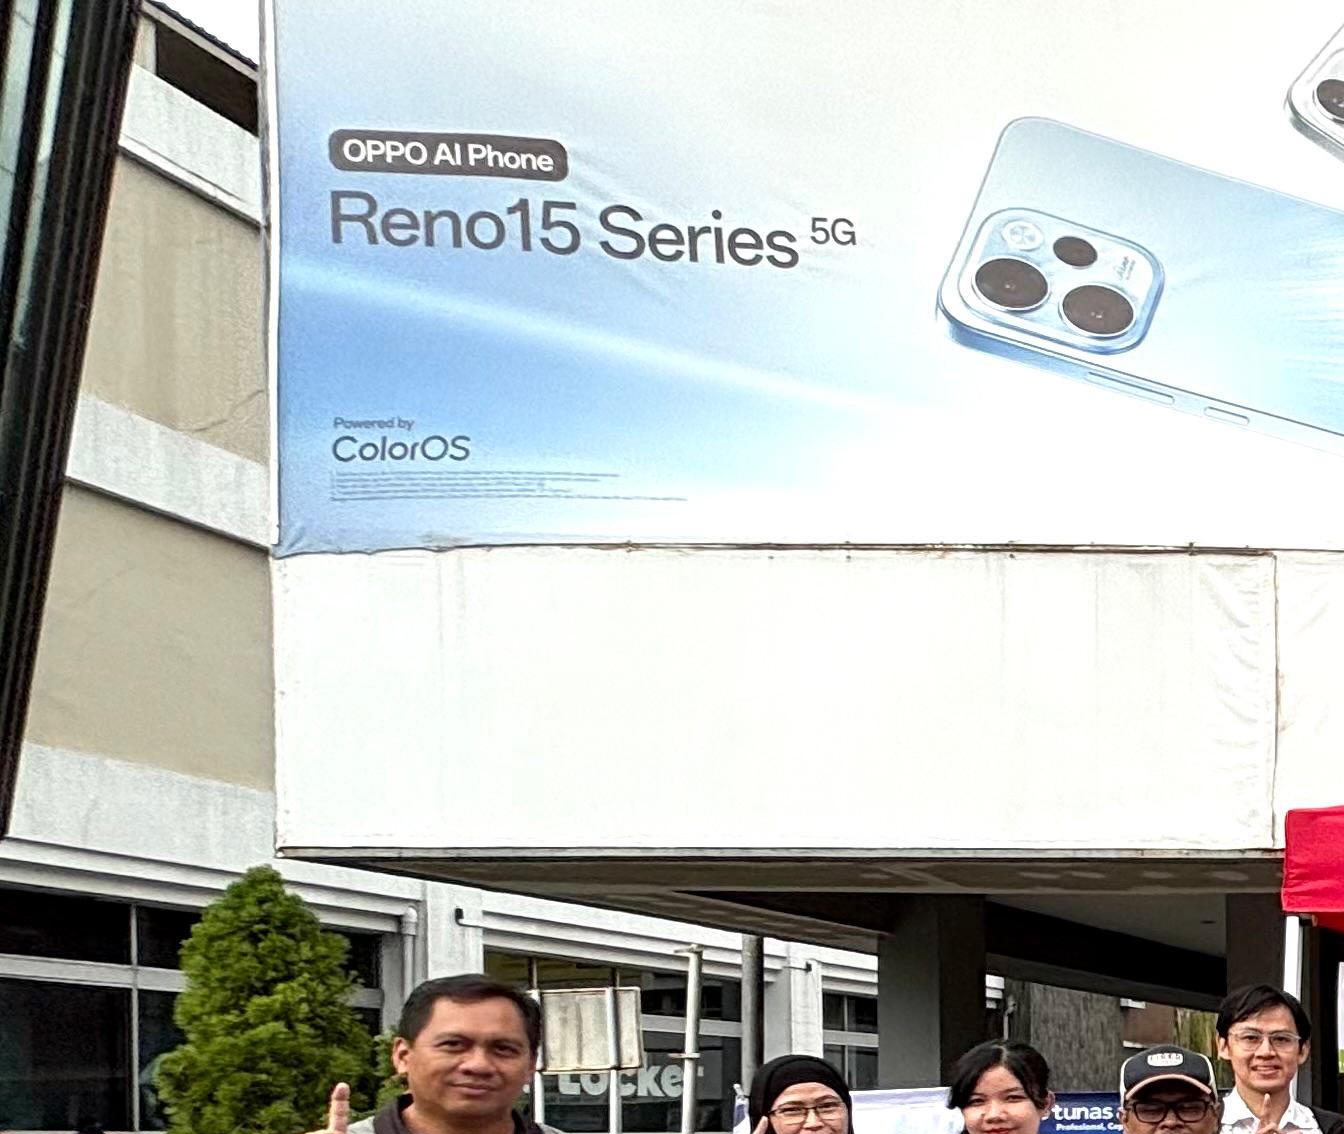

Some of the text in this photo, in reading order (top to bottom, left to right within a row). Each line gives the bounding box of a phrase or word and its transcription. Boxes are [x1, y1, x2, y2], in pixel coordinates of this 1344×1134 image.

[342, 138, 555, 172] OPPO AI Phone
[328, 190, 857, 269] Reno15 Series 5G
[333, 417, 415, 431] Powered by
[332, 435, 471, 463] ColorOS
[1051, 1105, 1114, 1120] tunas
